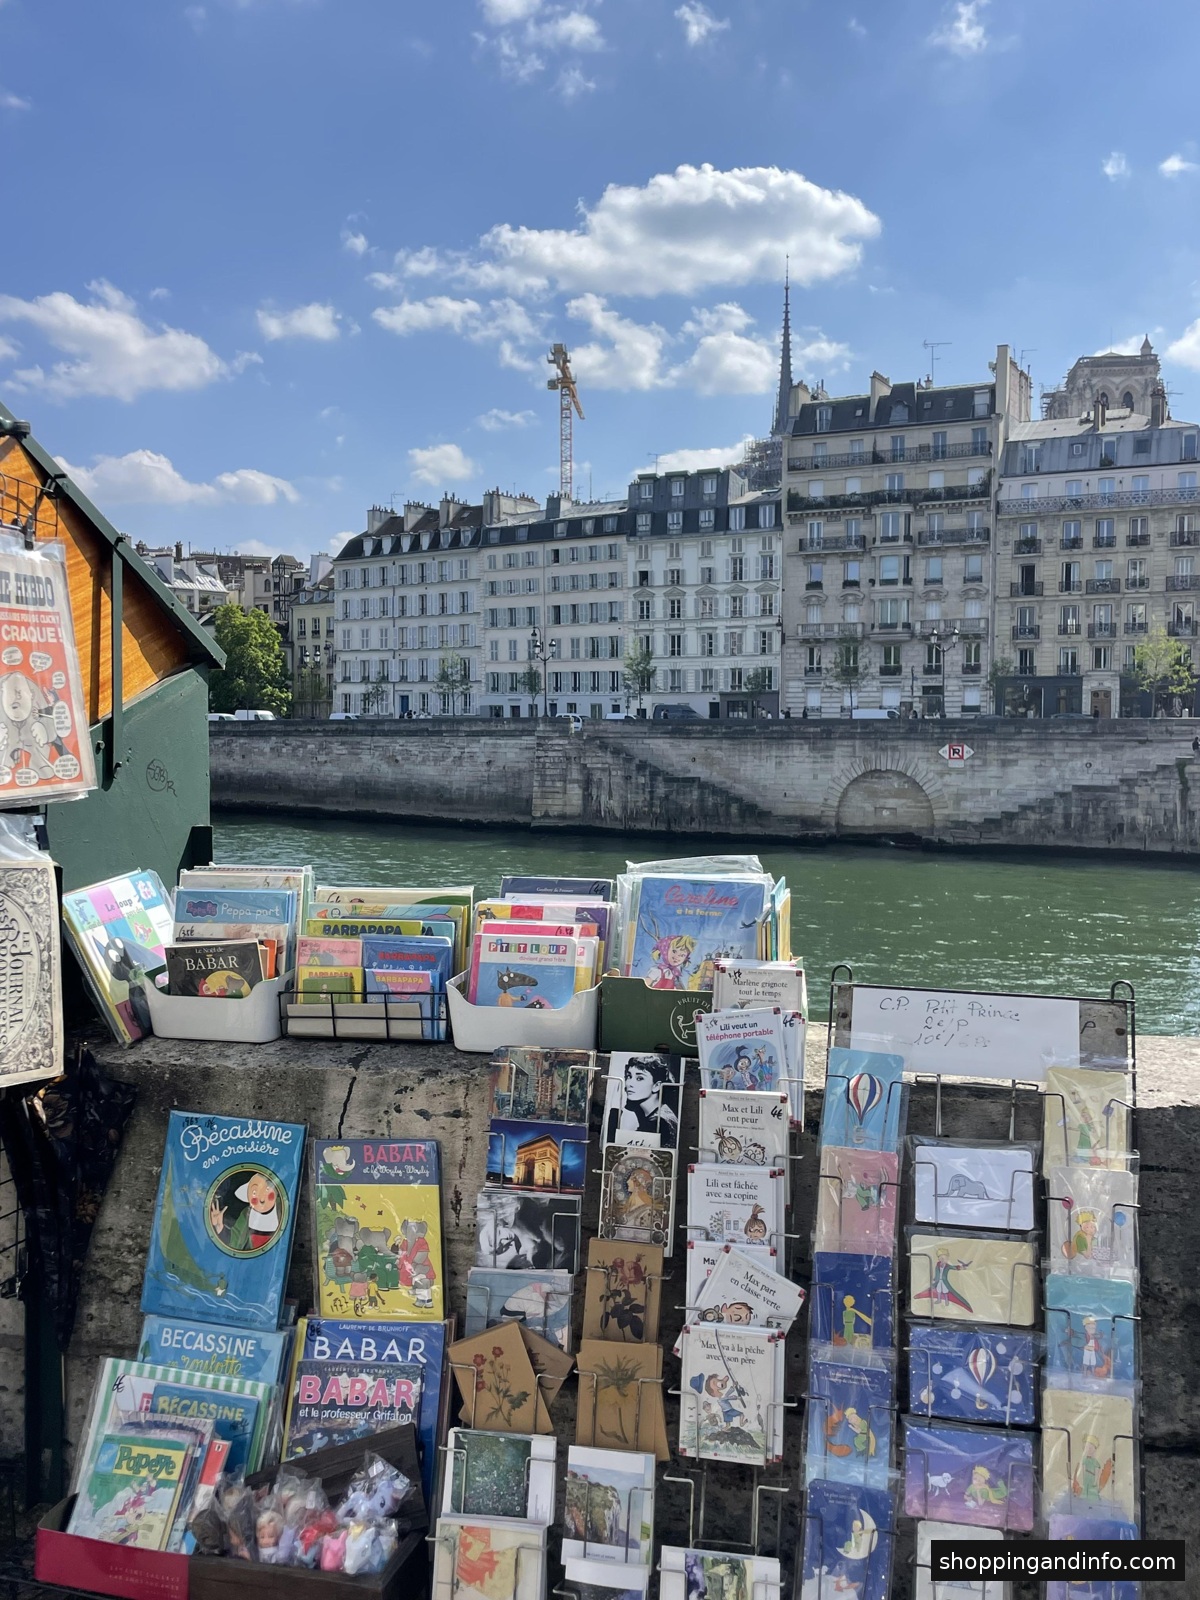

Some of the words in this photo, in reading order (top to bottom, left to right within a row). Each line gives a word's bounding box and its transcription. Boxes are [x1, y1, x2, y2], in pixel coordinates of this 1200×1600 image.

[15, 573, 55, 607] HEBDO
[664, 884, 739, 907] Caroline
[104, 903, 116, 912] Le
[221, 902, 252, 919] Peppa
[256, 906, 280, 920] part
[696, 908, 723, 917] ferme
[322, 924, 403, 936] BARBAPAPA
[530, 943, 567, 956] LOUP
[185, 955, 239, 971] BABAR
[9, 943, 33, 1029] JOURNAL
[375, 975, 424, 984] BARBAPAPA
[733, 978, 760, 987] Marlène
[761, 981, 788, 989] grignote
[754, 988, 761, 996] le
[762, 990, 782, 998] temps
[926, 999, 958, 1015] Petit
[719, 1023, 731, 1031] Lili
[731, 1022, 748, 1030] veut
[706, 1031, 741, 1042] téléphone
[742, 1028, 774, 1040] portable
[722, 1103, 739, 1113] Max
[750, 1105, 763, 1115] Lili
[770, 1105, 783, 1120] 4€
[726, 1115, 739, 1123] ont
[741, 1117, 759, 1125] peur
[180, 1120, 292, 1161] Bécassine
[363, 1143, 427, 1164] BABAR
[202, 1154, 220, 1169] en
[706, 1178, 719, 1188] Lili
[734, 1180, 759, 1191] fâchée
[705, 1190, 721, 1198] avec
[733, 1191, 758, 1201] copine
[743, 1271, 760, 1287] Max
[760, 1284, 777, 1297] part
[730, 1277, 740, 1286] en
[740, 1282, 761, 1300] classe
[762, 1296, 781, 1312] verte
[338, 1323, 366, 1331] LAURENT
[160, 1327, 257, 1358] BECASSINE
[313, 1336, 428, 1363] BABAR
[701, 1339, 717, 1350] Max
[731, 1343, 736, 1352] à
[737, 1343, 744, 1353] la
[745, 1345, 765, 1355] pêche
[705, 1353, 721, 1361] avec
[740, 1356, 756, 1366] père
[299, 1375, 415, 1409] BABAR
[299, 1406, 309, 1418] et
[311, 1407, 319, 1418] le
[321, 1408, 371, 1420] professeur
[373, 1410, 412, 1422] Grifaton
[115, 1444, 177, 1478] Popeye
